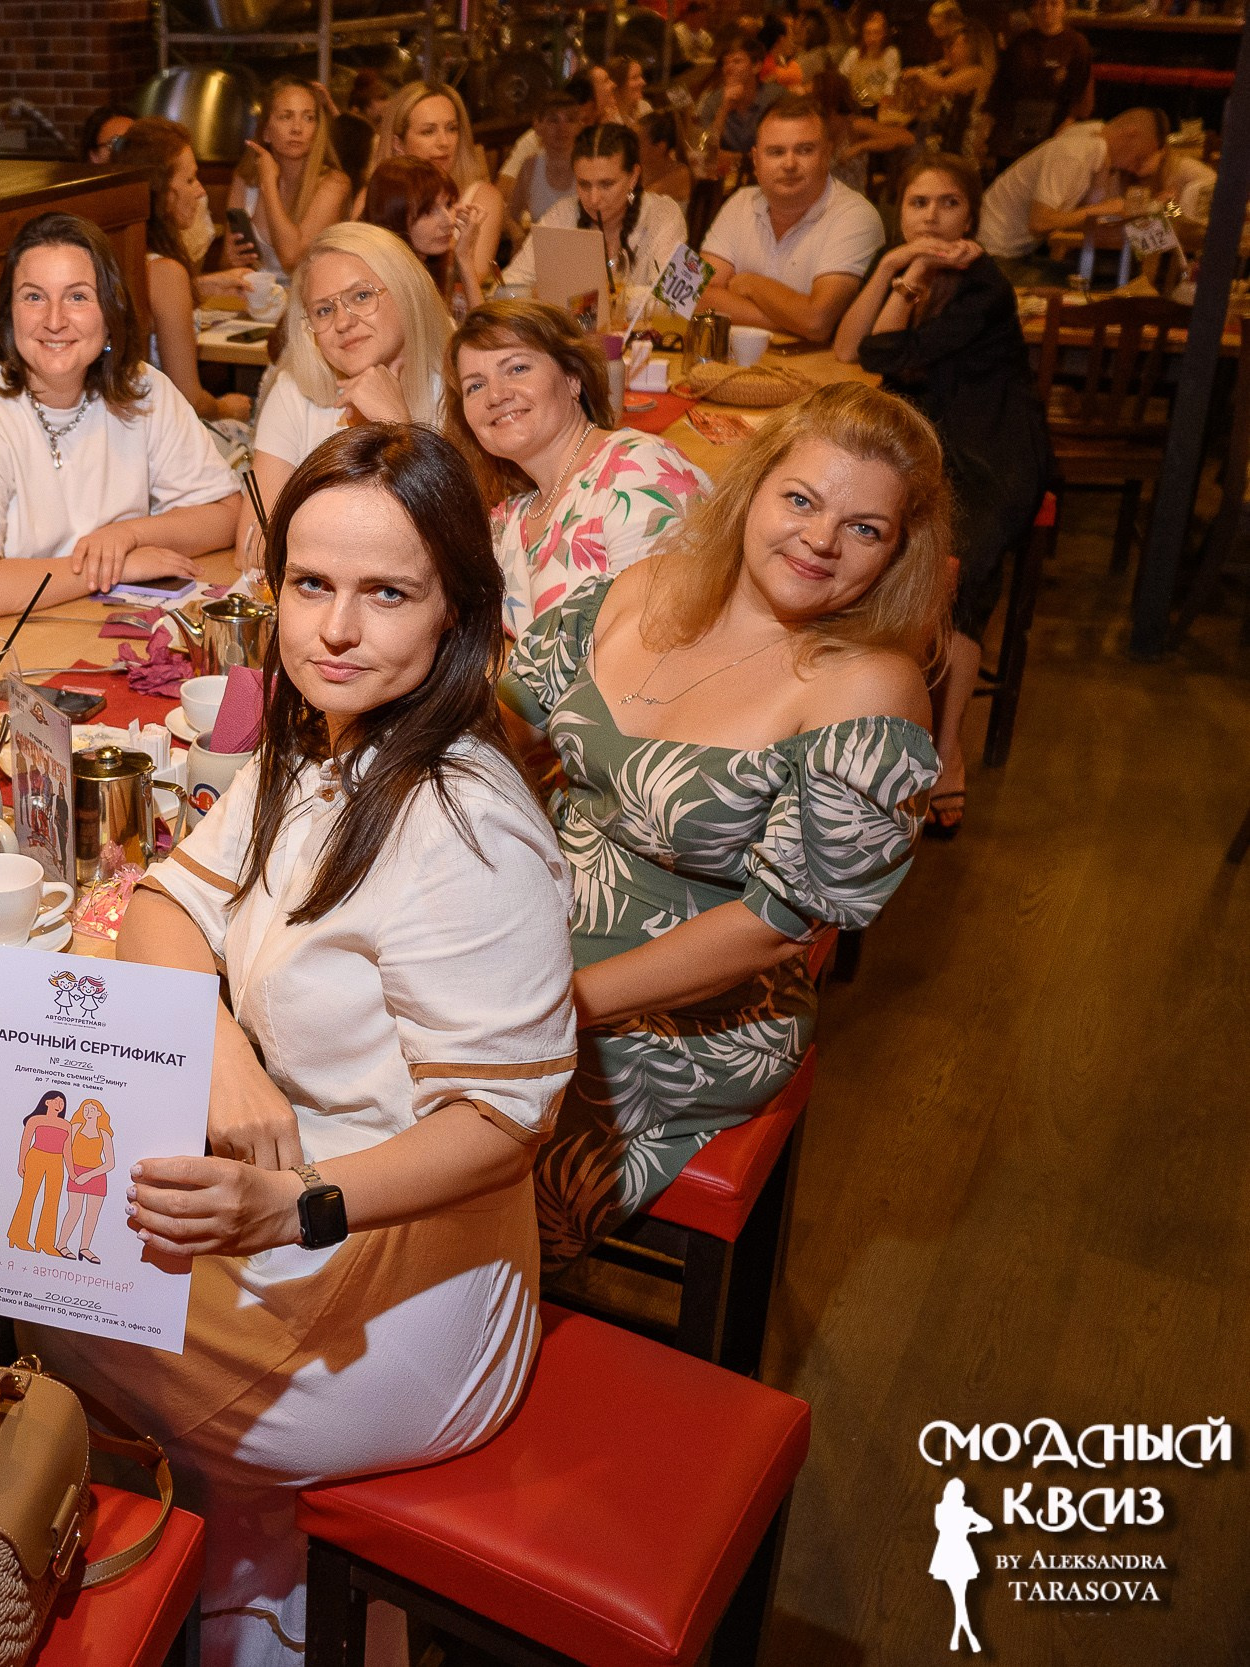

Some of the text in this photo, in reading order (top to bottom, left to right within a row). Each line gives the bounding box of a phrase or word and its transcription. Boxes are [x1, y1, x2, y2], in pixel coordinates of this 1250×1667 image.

[665, 274, 694, 307] 102
[80, 1040, 187, 1067] СЕРТИФИКАТ
[15, 1064, 65, 1078] Длительность
[66, 1073, 93, 1082] съемки
[106, 1079, 127, 1088] минут
[32, 1265, 135, 1293] автопортретная?
[23, 1291, 33, 1299] до
[24, 1301, 56, 1313] Ванцетти
[57, 1307, 68, 1317] 50,
[69, 1310, 93, 1321] корпус
[94, 1315, 101, 1323] 3,
[102, 1318, 119, 1326] этаж
[120, 1320, 127, 1328] 3,
[128, 1322, 146, 1332] офис
[147, 1326, 162, 1335] 300
